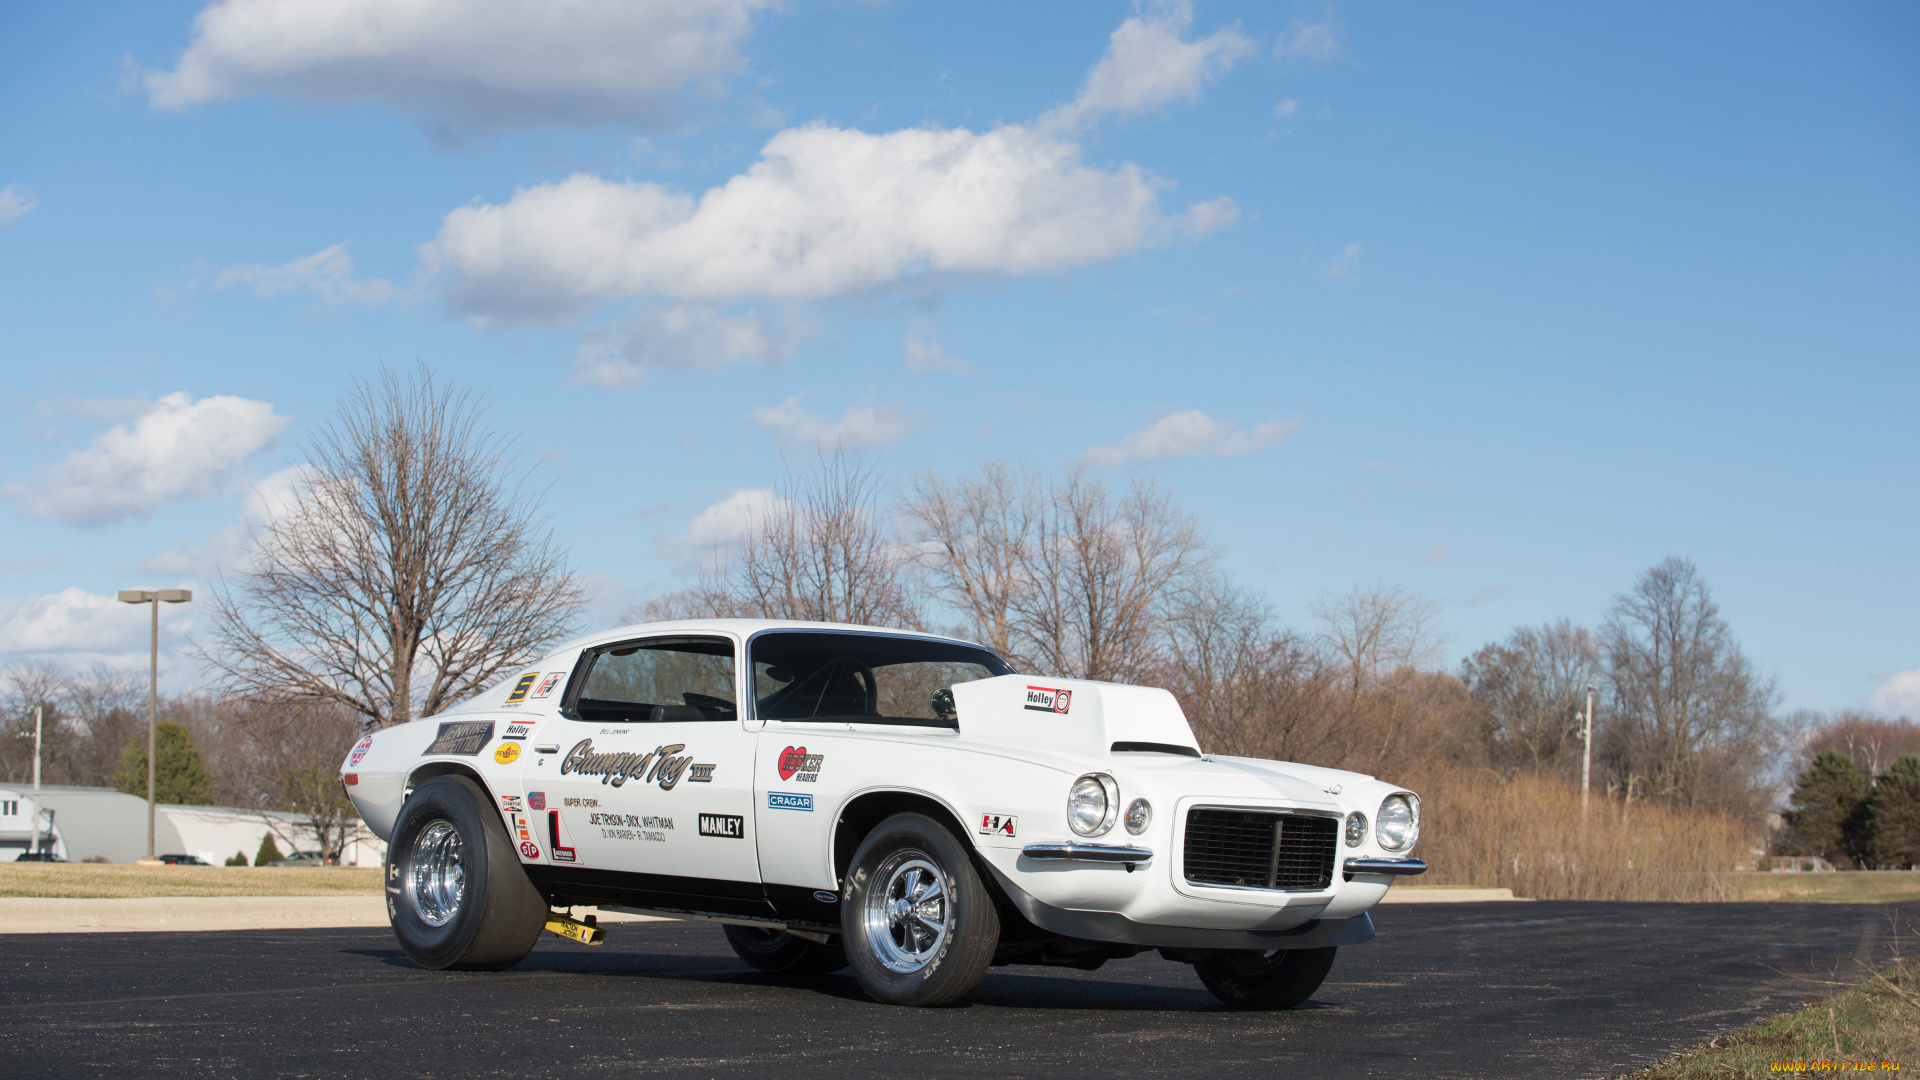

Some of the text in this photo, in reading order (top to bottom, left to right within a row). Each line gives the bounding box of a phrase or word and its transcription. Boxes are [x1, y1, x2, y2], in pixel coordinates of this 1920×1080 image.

[1027, 690, 1054, 707] Holley
[438, 723, 490, 742] JENKINS
[506, 724, 531, 736] Holley
[432, 733, 485, 753] COMPETITION
[647, 743, 694, 791] Toy
[782, 752, 824, 773] HOOKER
[795, 772, 818, 783] HEADERS
[563, 797, 582, 807] SUPER
[770, 796, 810, 807] CRAGAR
[589, 813, 601, 826] JOE
[642, 816, 675, 830] WHITMAN
[701, 816, 741, 836] MANLEY
[521, 842, 538, 857] STP
[560, 920, 579, 932] TRACTION
[923, 918, 957, 980] FRONT
